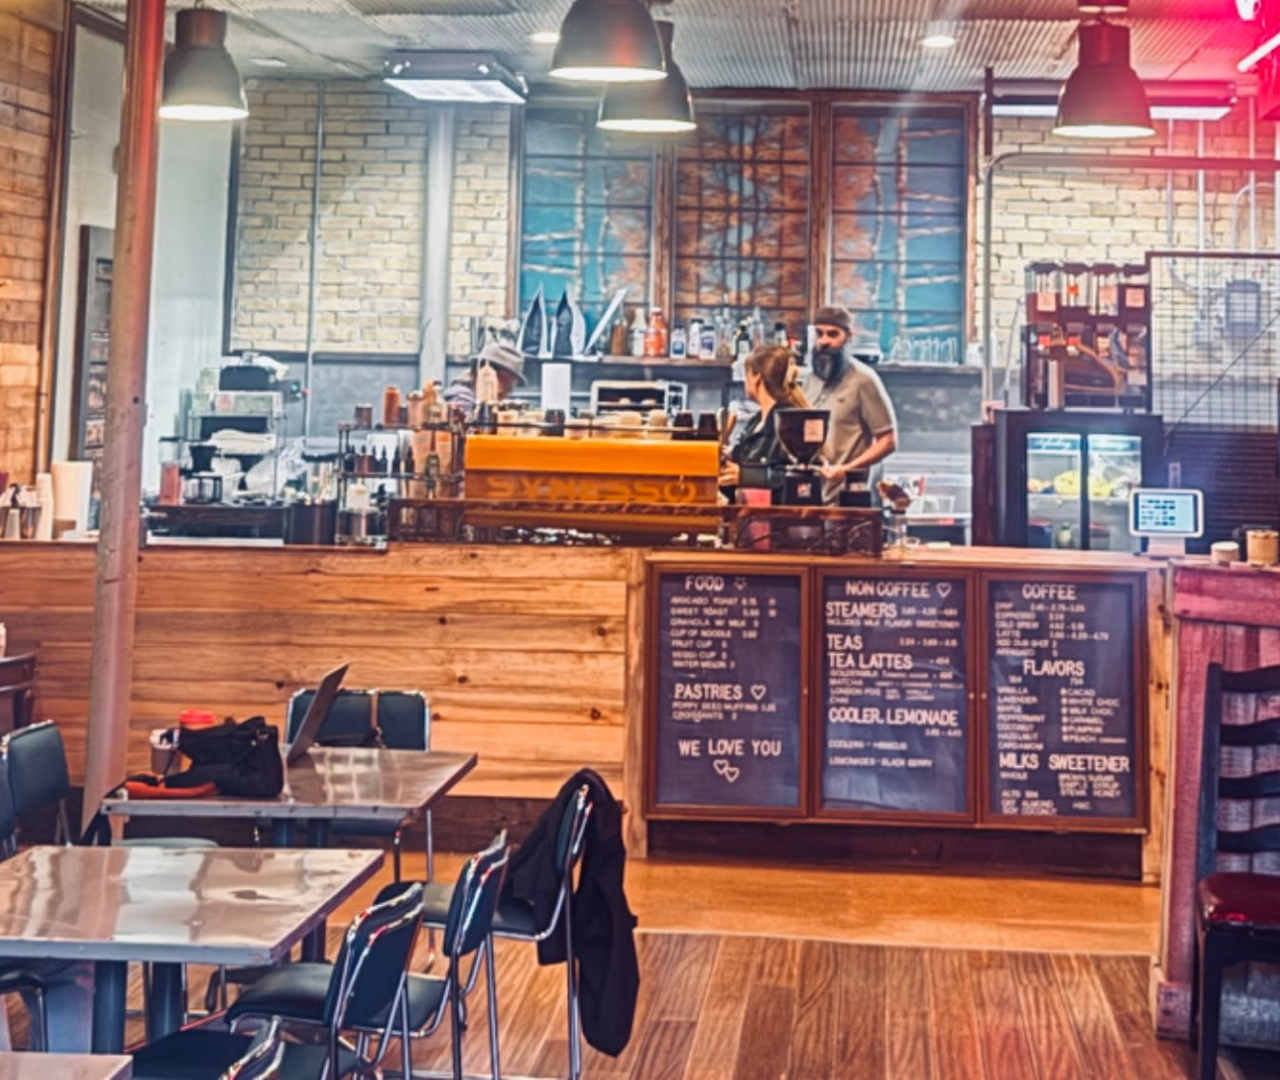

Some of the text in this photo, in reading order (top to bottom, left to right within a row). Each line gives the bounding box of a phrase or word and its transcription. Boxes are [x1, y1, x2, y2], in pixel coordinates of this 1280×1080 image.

[685, 575, 725, 591] FOOD
[845, 580, 930, 599] NON COFFEE
[1022, 583, 1077, 600] COFFEE
[825, 601, 897, 618] STEAMERS
[826, 633, 863, 650] TEAS
[827, 651, 856, 668] TEA
[858, 652, 913, 670] LATTES
[1023, 659, 1085, 677] FLAVORS
[674, 683, 742, 700] PASTRIES
[885, 707, 959, 727] LEMONADE
[678, 738, 782, 757] WE LOVE YOU
[999, 751, 1130, 773] MILKS SWEETENER
